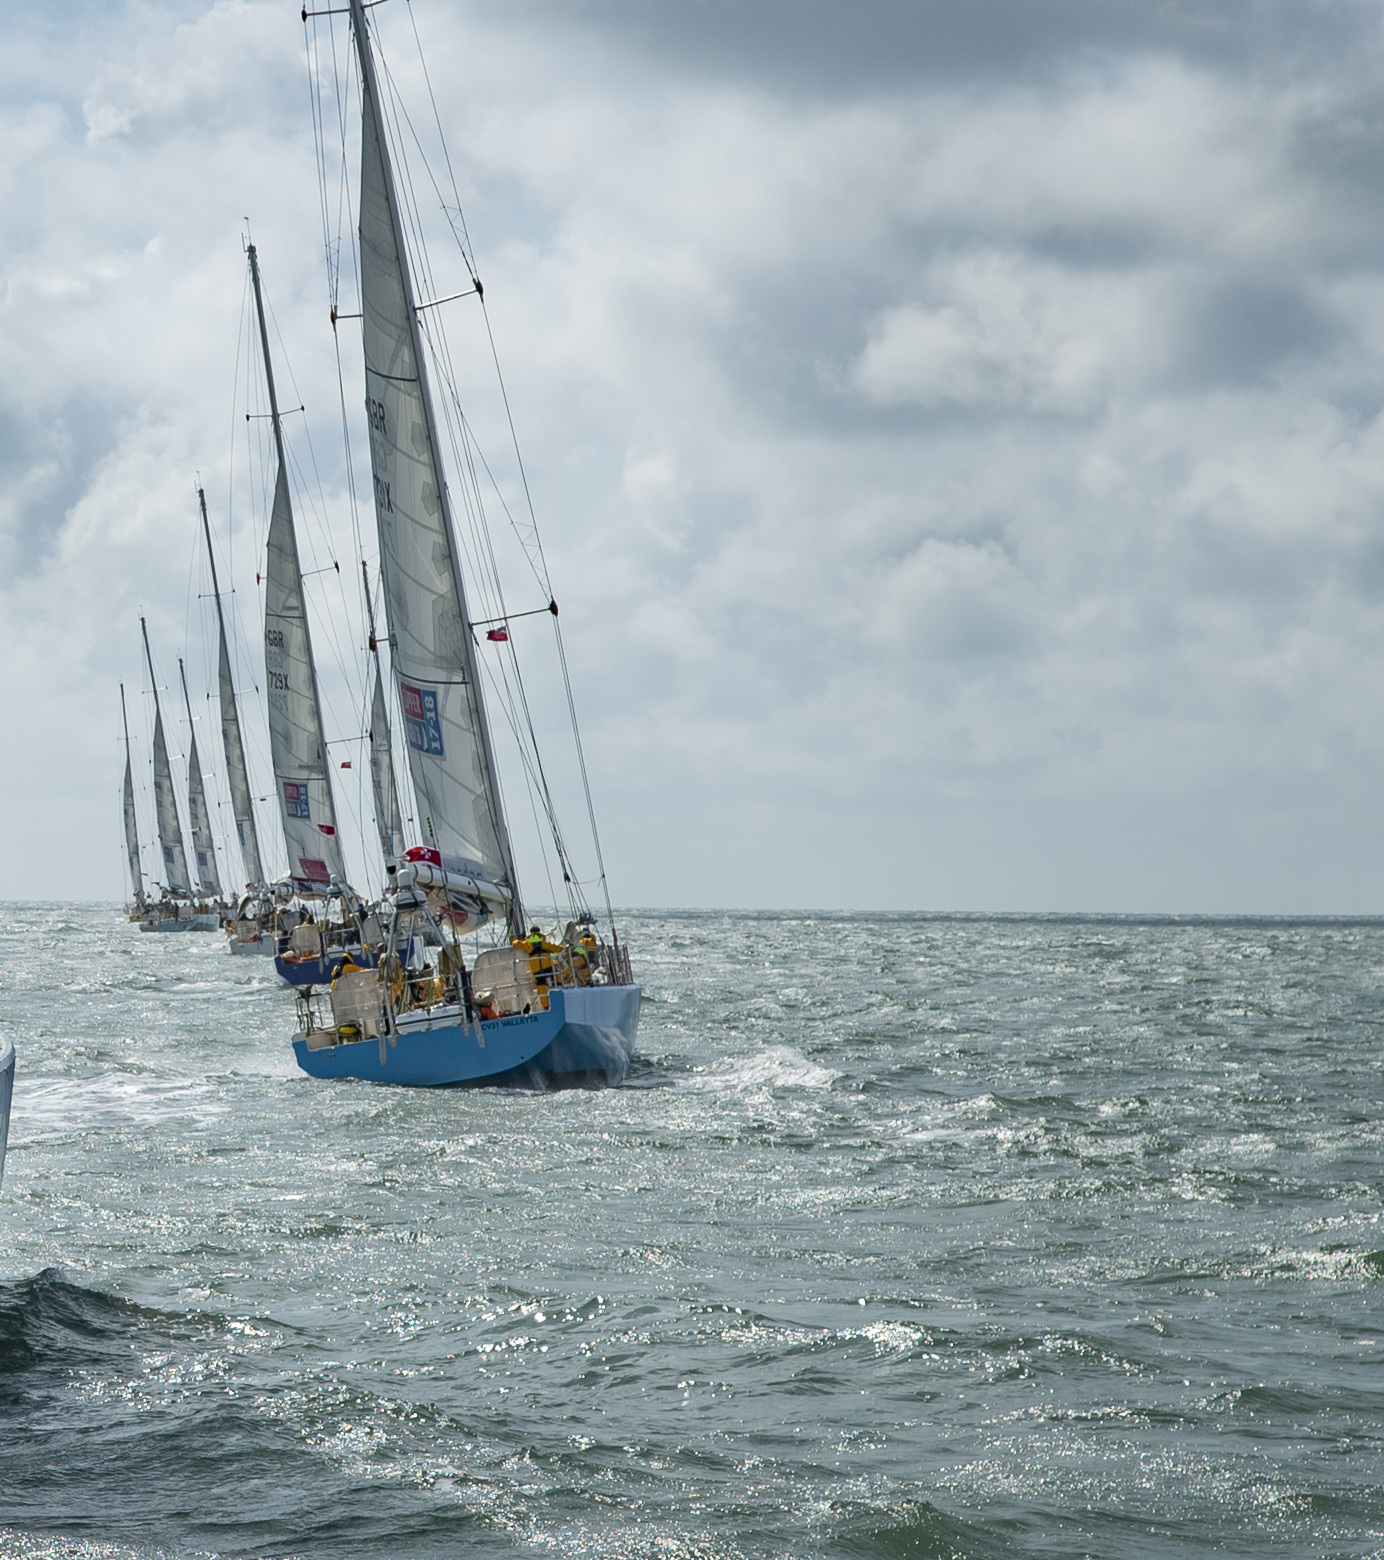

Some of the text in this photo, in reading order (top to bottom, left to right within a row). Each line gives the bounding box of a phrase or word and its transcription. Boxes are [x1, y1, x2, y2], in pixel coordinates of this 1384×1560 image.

[267, 629, 285, 648] GBR
[424, 695, 442, 750] 17-18
[501, 1015, 539, 1028] VALLETTA
